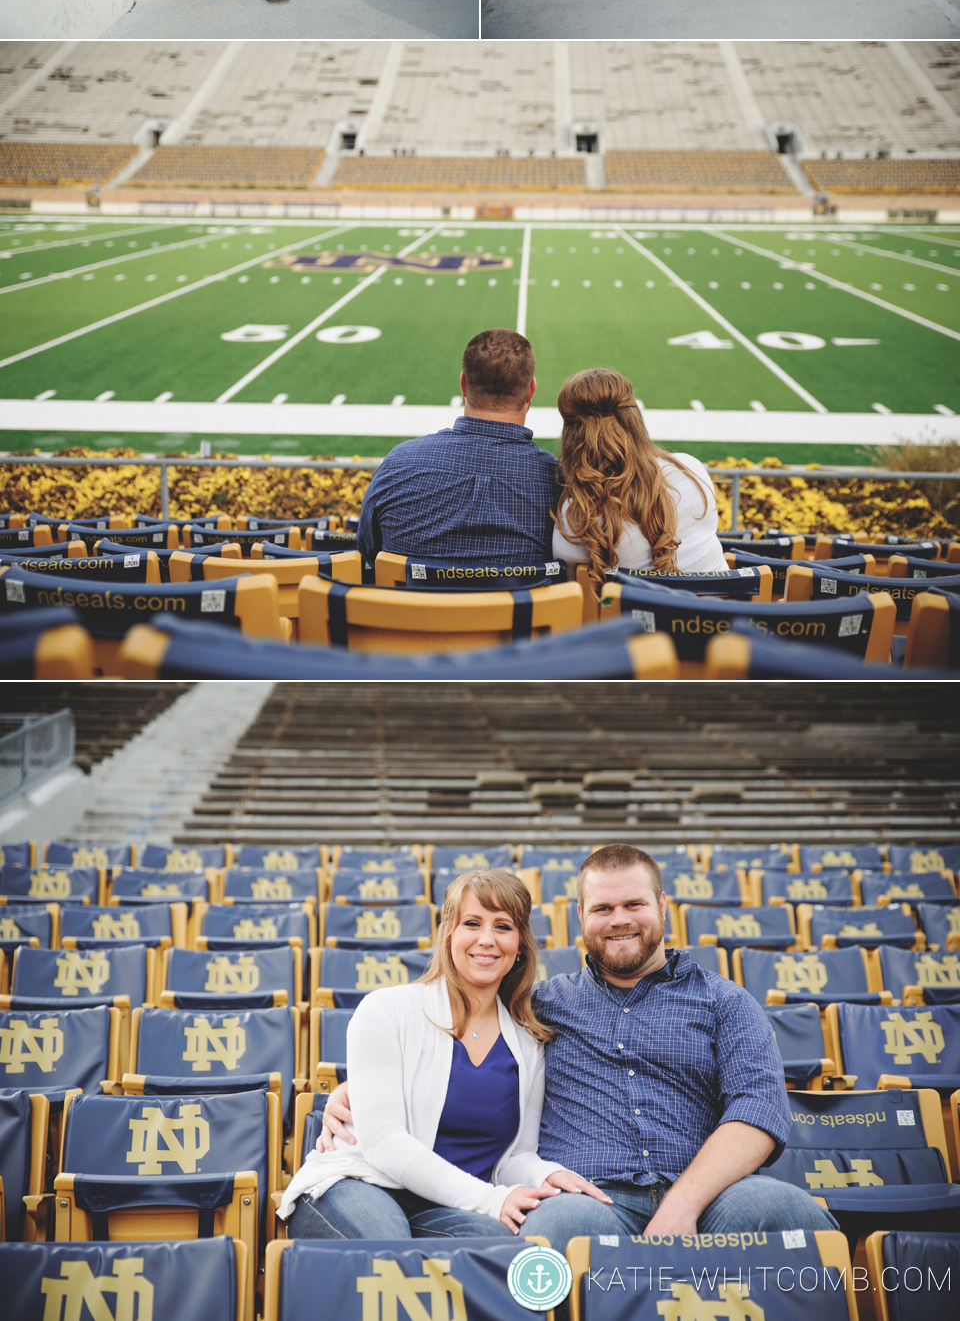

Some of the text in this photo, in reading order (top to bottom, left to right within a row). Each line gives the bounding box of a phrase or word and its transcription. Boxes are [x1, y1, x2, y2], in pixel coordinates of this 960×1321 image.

[220, 323, 382, 344] 50
[667, 330, 826, 351] 40
[86, 535, 147, 544] ndsats.com
[436, 564, 537, 579] ndseats.com
[37, 587, 186, 612] ndseats.com
[671, 615, 826, 637] ndses.com
